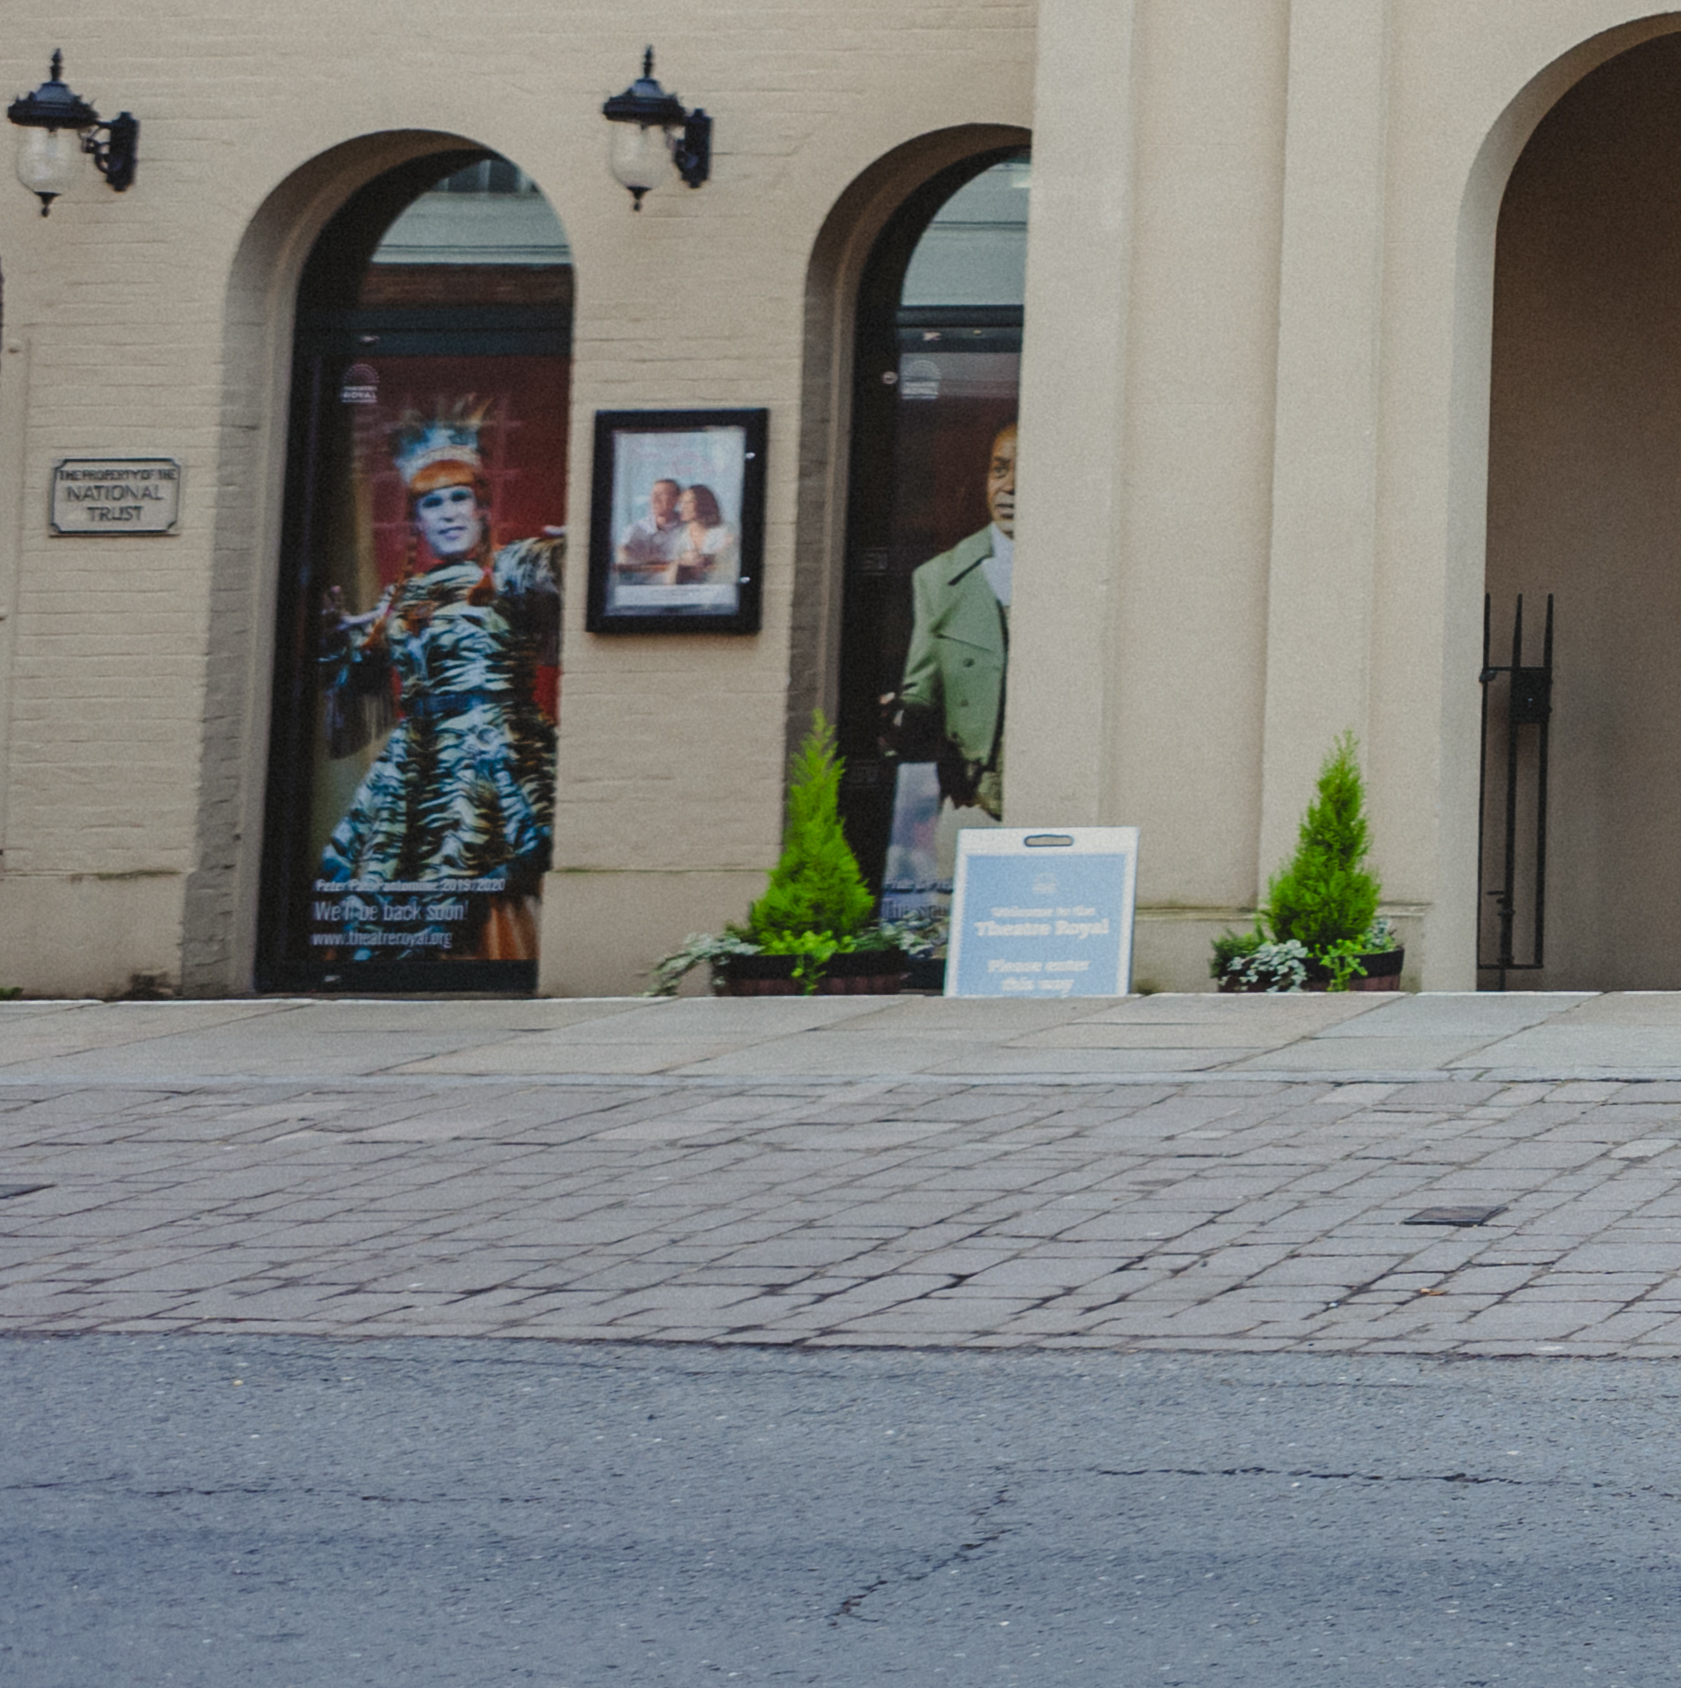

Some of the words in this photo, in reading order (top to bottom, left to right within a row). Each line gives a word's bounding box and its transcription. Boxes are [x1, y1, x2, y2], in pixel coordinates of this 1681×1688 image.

[66, 484, 164, 501] NATIONAL
[86, 505, 144, 521] TRUST
[359, 903, 378, 920] be
[383, 902, 421, 920] back
[425, 901, 468, 920] soon!
[974, 921, 1051, 936] Theatre
[1054, 919, 1110, 939] Royal
[313, 931, 453, 948] www.theatreroyal.org
[988, 959, 1042, 973] Please
[1045, 961, 1091, 971] enter
[1002, 977, 1035, 991] this
[1038, 979, 1074, 993] way
